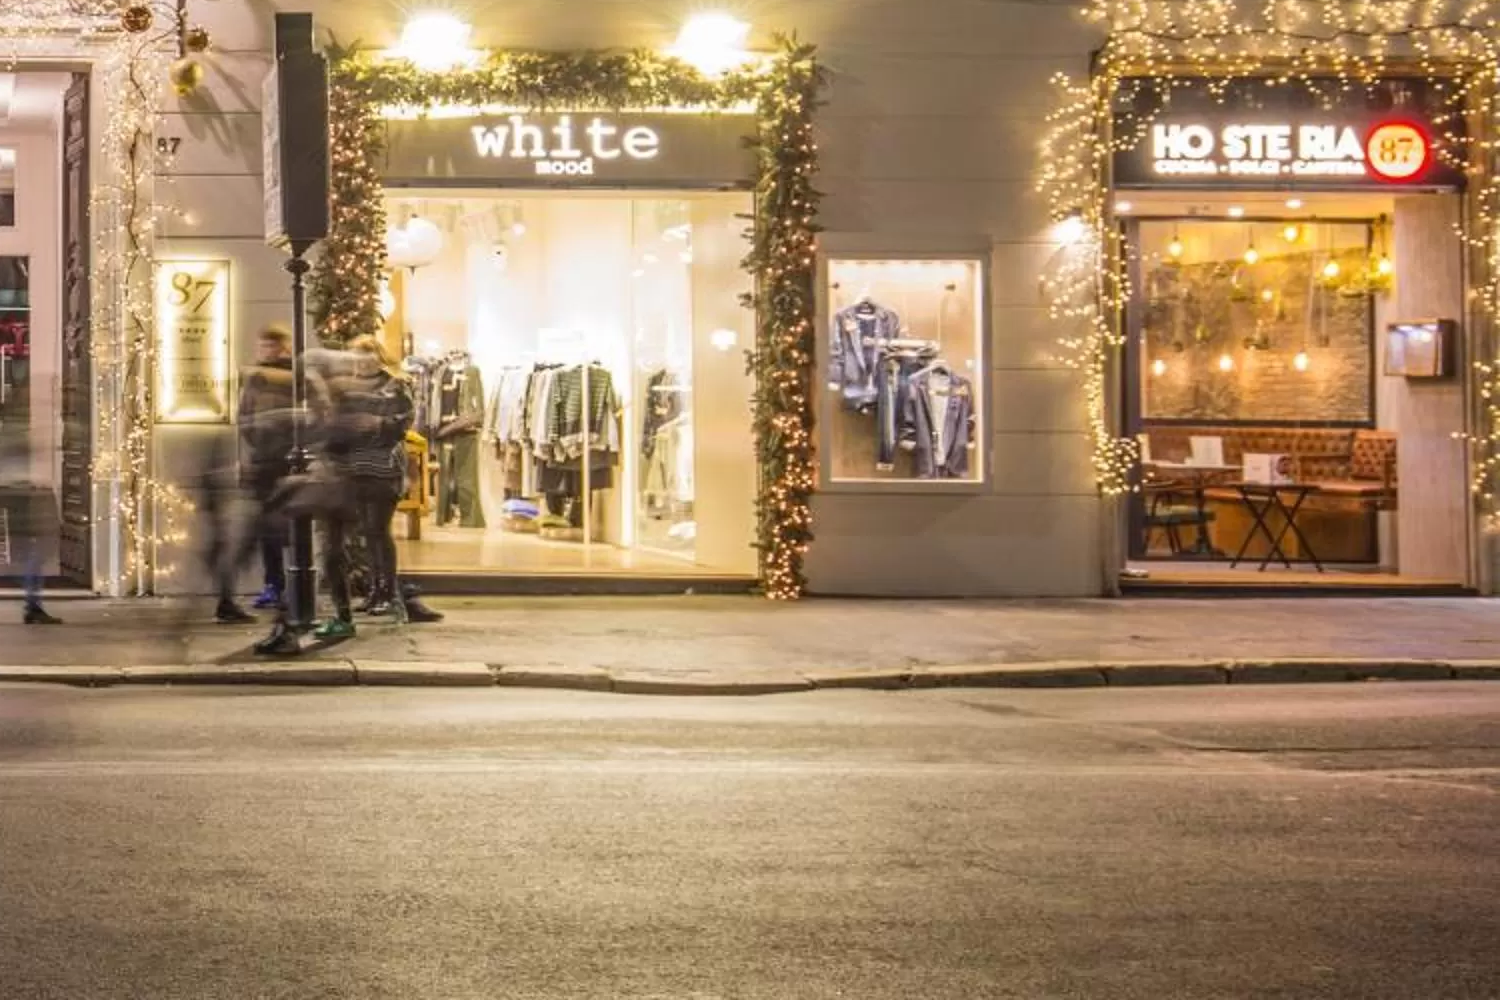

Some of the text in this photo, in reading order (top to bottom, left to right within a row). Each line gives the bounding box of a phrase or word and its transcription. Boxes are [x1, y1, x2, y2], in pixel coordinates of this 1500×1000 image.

[470, 114, 660, 159] white
[1153, 125, 1414, 163] HO STE RIA 87
[535, 157, 594, 175] mood
[168, 271, 217, 313] 87
